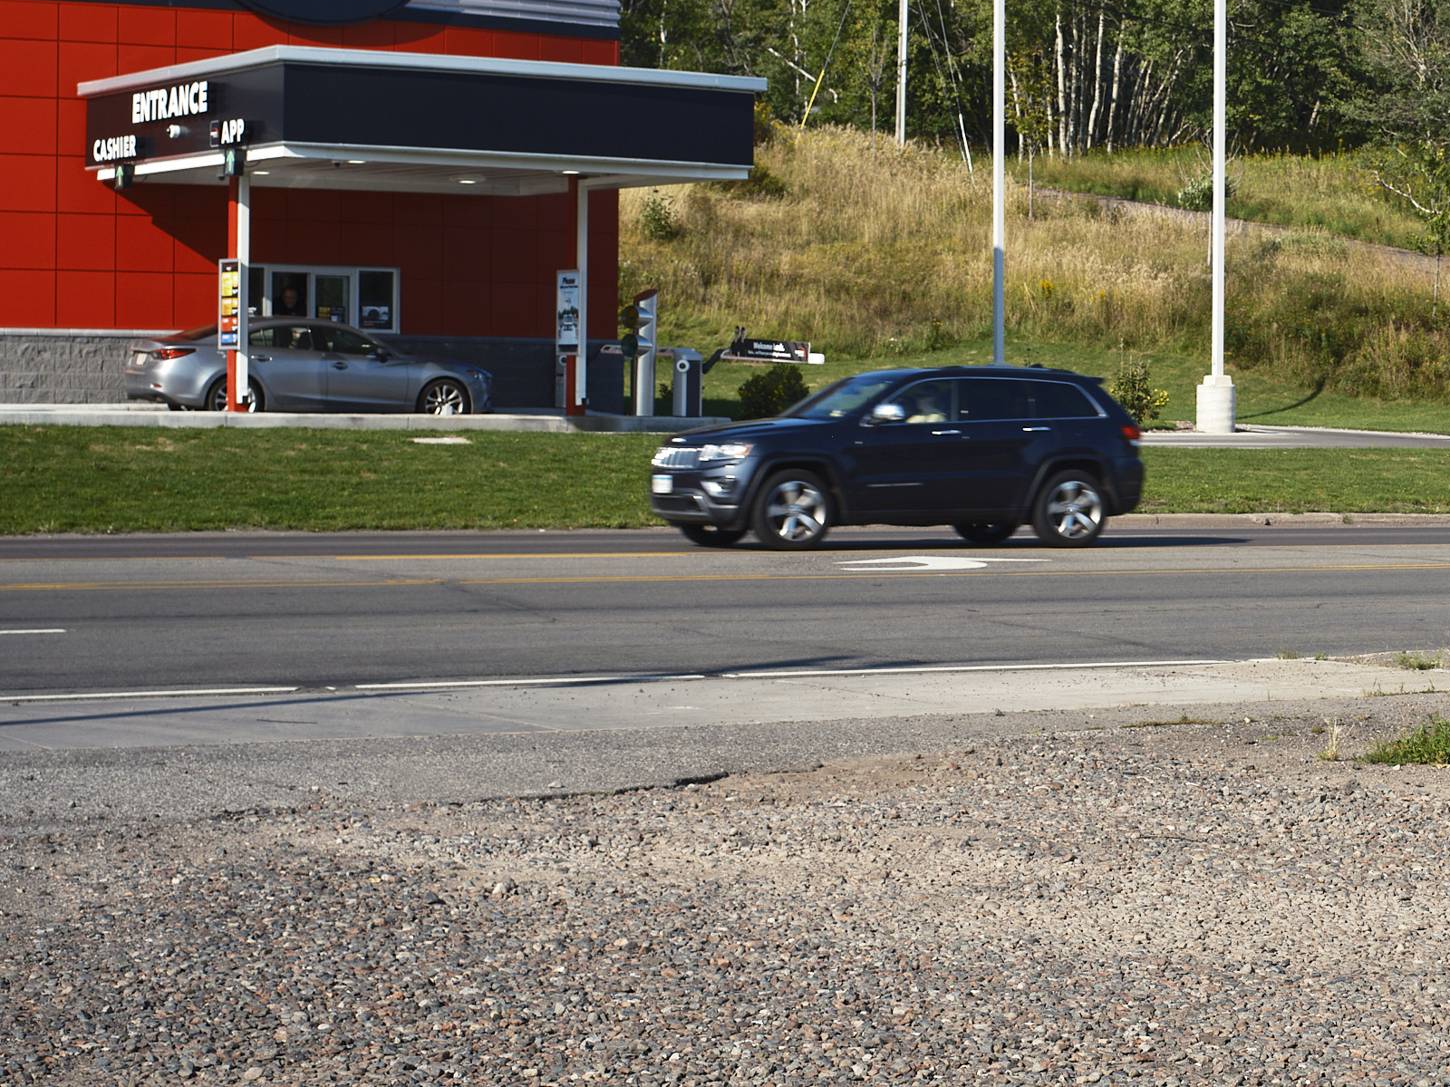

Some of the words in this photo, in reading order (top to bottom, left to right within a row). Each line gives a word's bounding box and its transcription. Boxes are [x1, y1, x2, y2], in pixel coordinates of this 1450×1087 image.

[132, 81, 209, 124] ENTRANCE
[220, 118, 245, 145] APP
[93, 135, 137, 162] CASHIER
